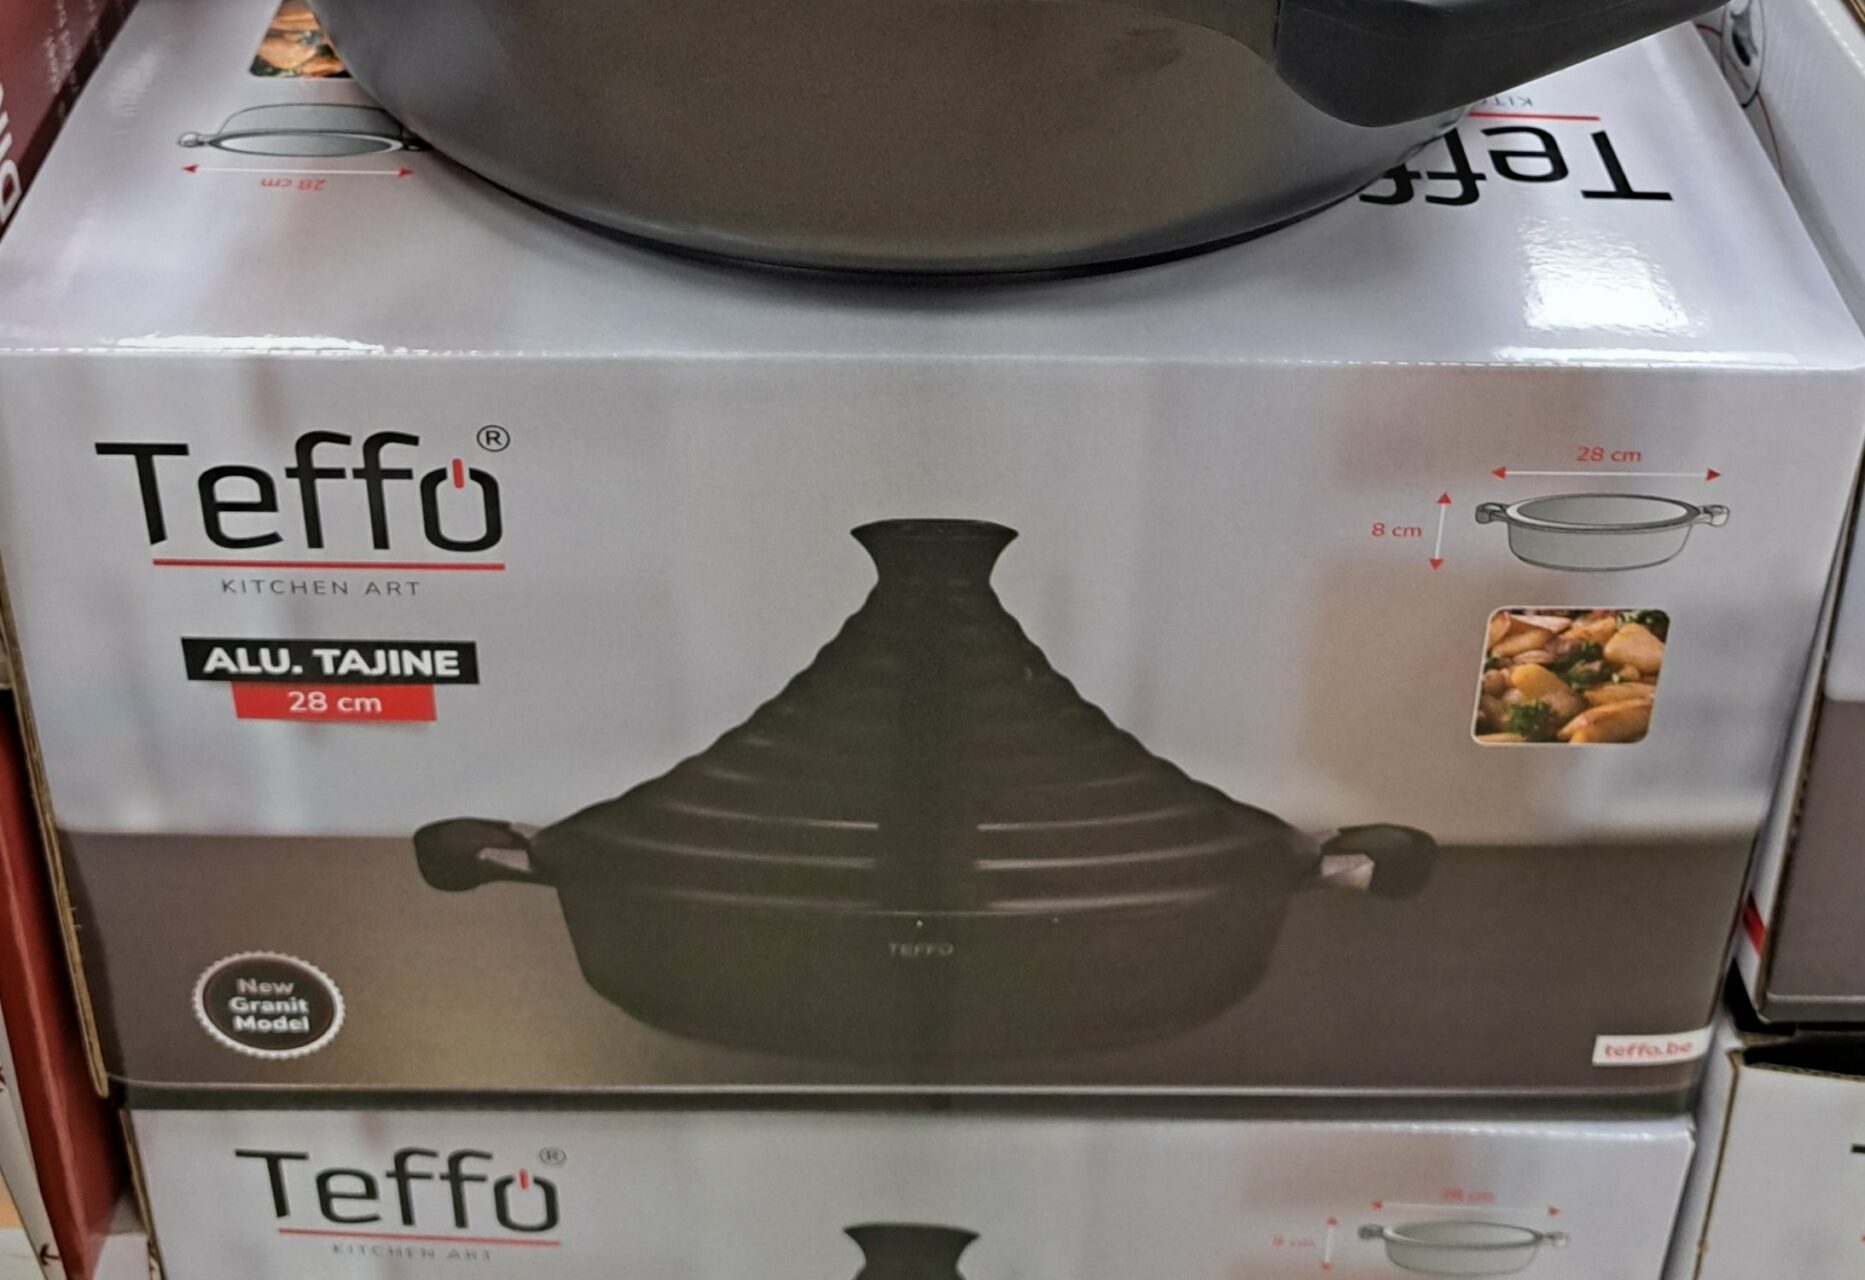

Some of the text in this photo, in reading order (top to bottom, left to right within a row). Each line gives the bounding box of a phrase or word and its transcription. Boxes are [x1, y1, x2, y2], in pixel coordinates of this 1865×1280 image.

[1359, 126, 1673, 206] Teff
[1576, 446, 1642, 463] 28 cm
[95, 430, 504, 553] Teffo
[1371, 522, 1423, 538] 8 cm
[221, 579, 421, 597] KITCHEN ART
[203, 646, 461, 677] ALU. TAJINE
[287, 691, 383, 713] 28 cm
[888, 942, 954, 957] TEFFO
[236, 977, 295, 995] New
[228, 995, 310, 1014] Granit
[233, 1015, 310, 1034] Model
[1605, 1041, 1693, 1057] teffo.be
[234, 1147, 560, 1233] Teffo
